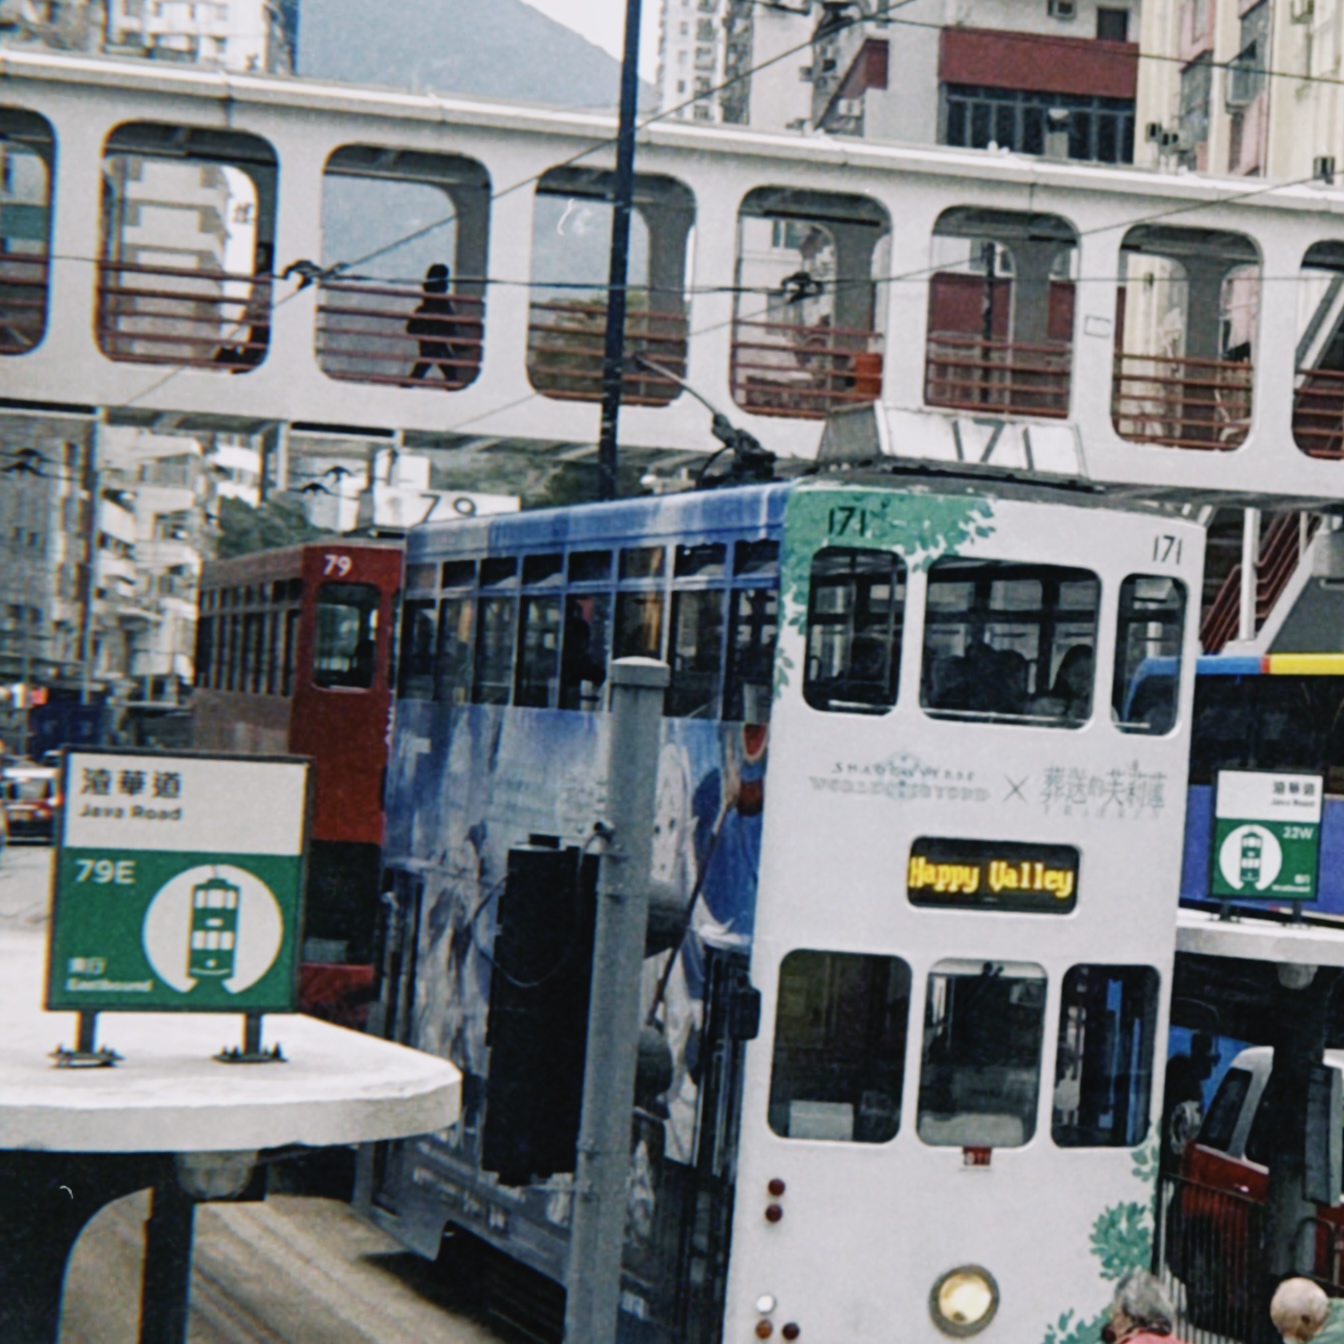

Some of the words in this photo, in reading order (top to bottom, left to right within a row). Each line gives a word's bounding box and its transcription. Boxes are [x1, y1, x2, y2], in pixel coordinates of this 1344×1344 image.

[951, 418, 1035, 472] 171
[827, 506, 867, 537] 171
[323, 553, 353, 577] 79
[1152, 534, 1184, 565] 171
[81, 767, 182, 799] 渣華道
[79, 804, 125, 820] Java
[130, 805, 182, 821] Road
[1283, 826, 1314, 839] 22W
[75, 859, 136, 885] 79E
[908, 856, 980, 894] Happy
[989, 861, 1074, 898] Valley
